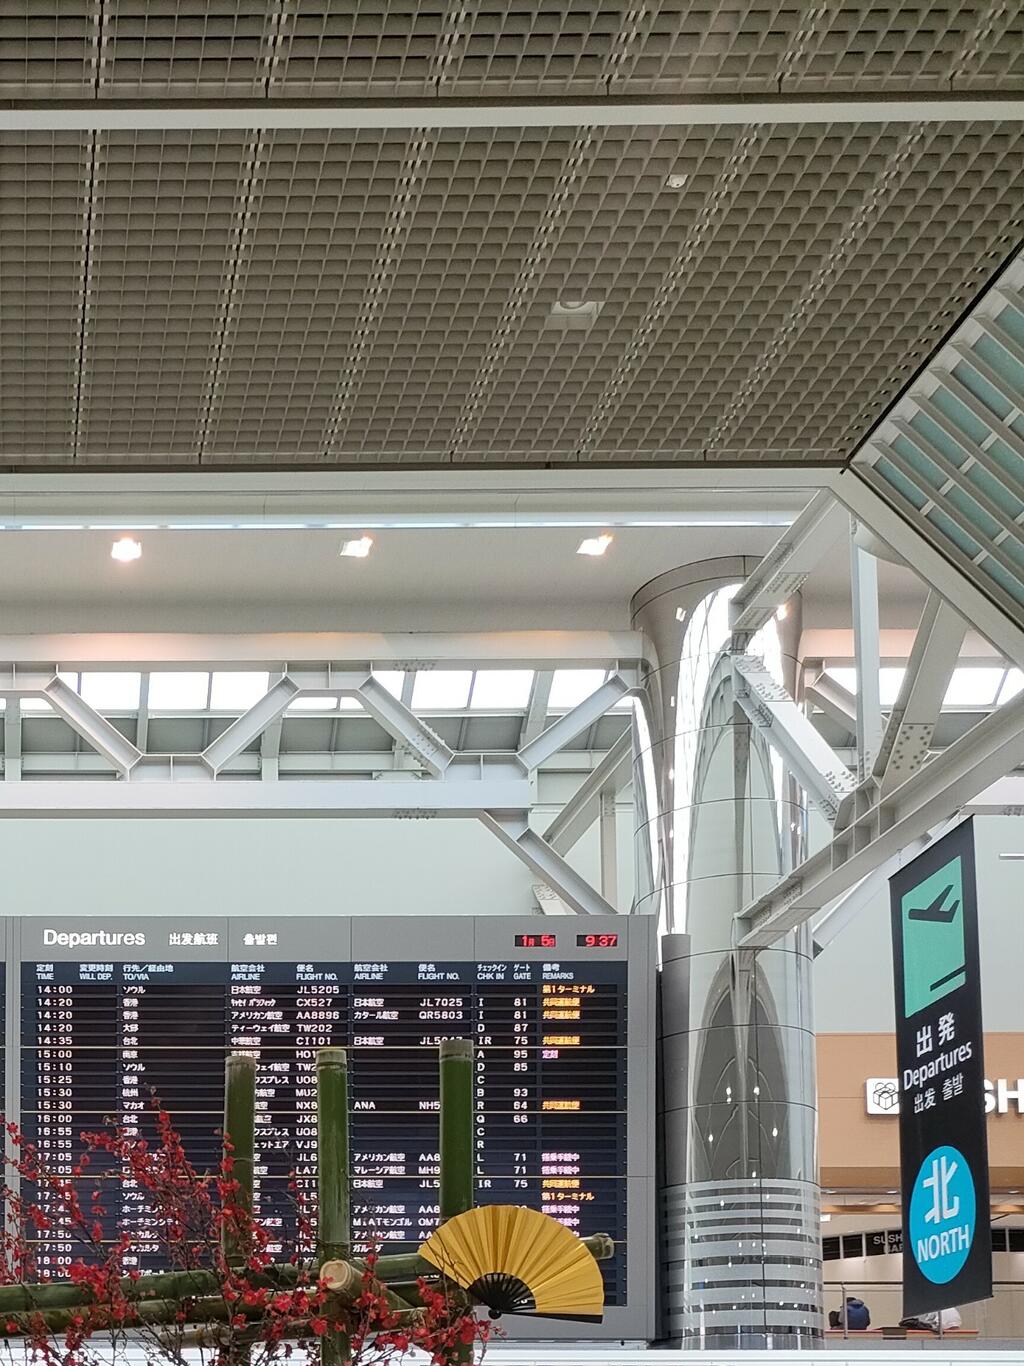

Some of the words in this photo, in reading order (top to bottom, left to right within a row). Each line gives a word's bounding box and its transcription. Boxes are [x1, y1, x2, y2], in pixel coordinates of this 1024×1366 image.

[44, 930, 145, 947] Departures
[170, 933, 218, 945] 出发航班
[297, 964, 313, 972] 便名
[121, 986, 145, 995] ソウル
[420, 998, 462, 1006] JL7025
[514, 998, 526, 1006] 81
[38, 1011, 72, 1019] 14:20
[296, 1011, 339, 1019] AA8896
[419, 1011, 462, 1019] QR5803
[514, 1011, 526, 1019] 81
[38, 1024, 72, 1032] 14:20
[297, 1024, 332, 1032] TW202
[514, 1024, 528, 1032] 87
[916, 1011, 955, 1058] 出発
[296, 1037, 330, 1045] CI101
[38, 1050, 72, 1058] 15:00
[38, 1063, 72, 1071] 15:10
[903, 1041, 972, 1091] Departures
[914, 1087, 937, 1114] 出发
[942, 1072, 964, 1101] 출발
[922, 1154, 960, 1225] 北
[917, 1224, 969, 1263] NORTH
